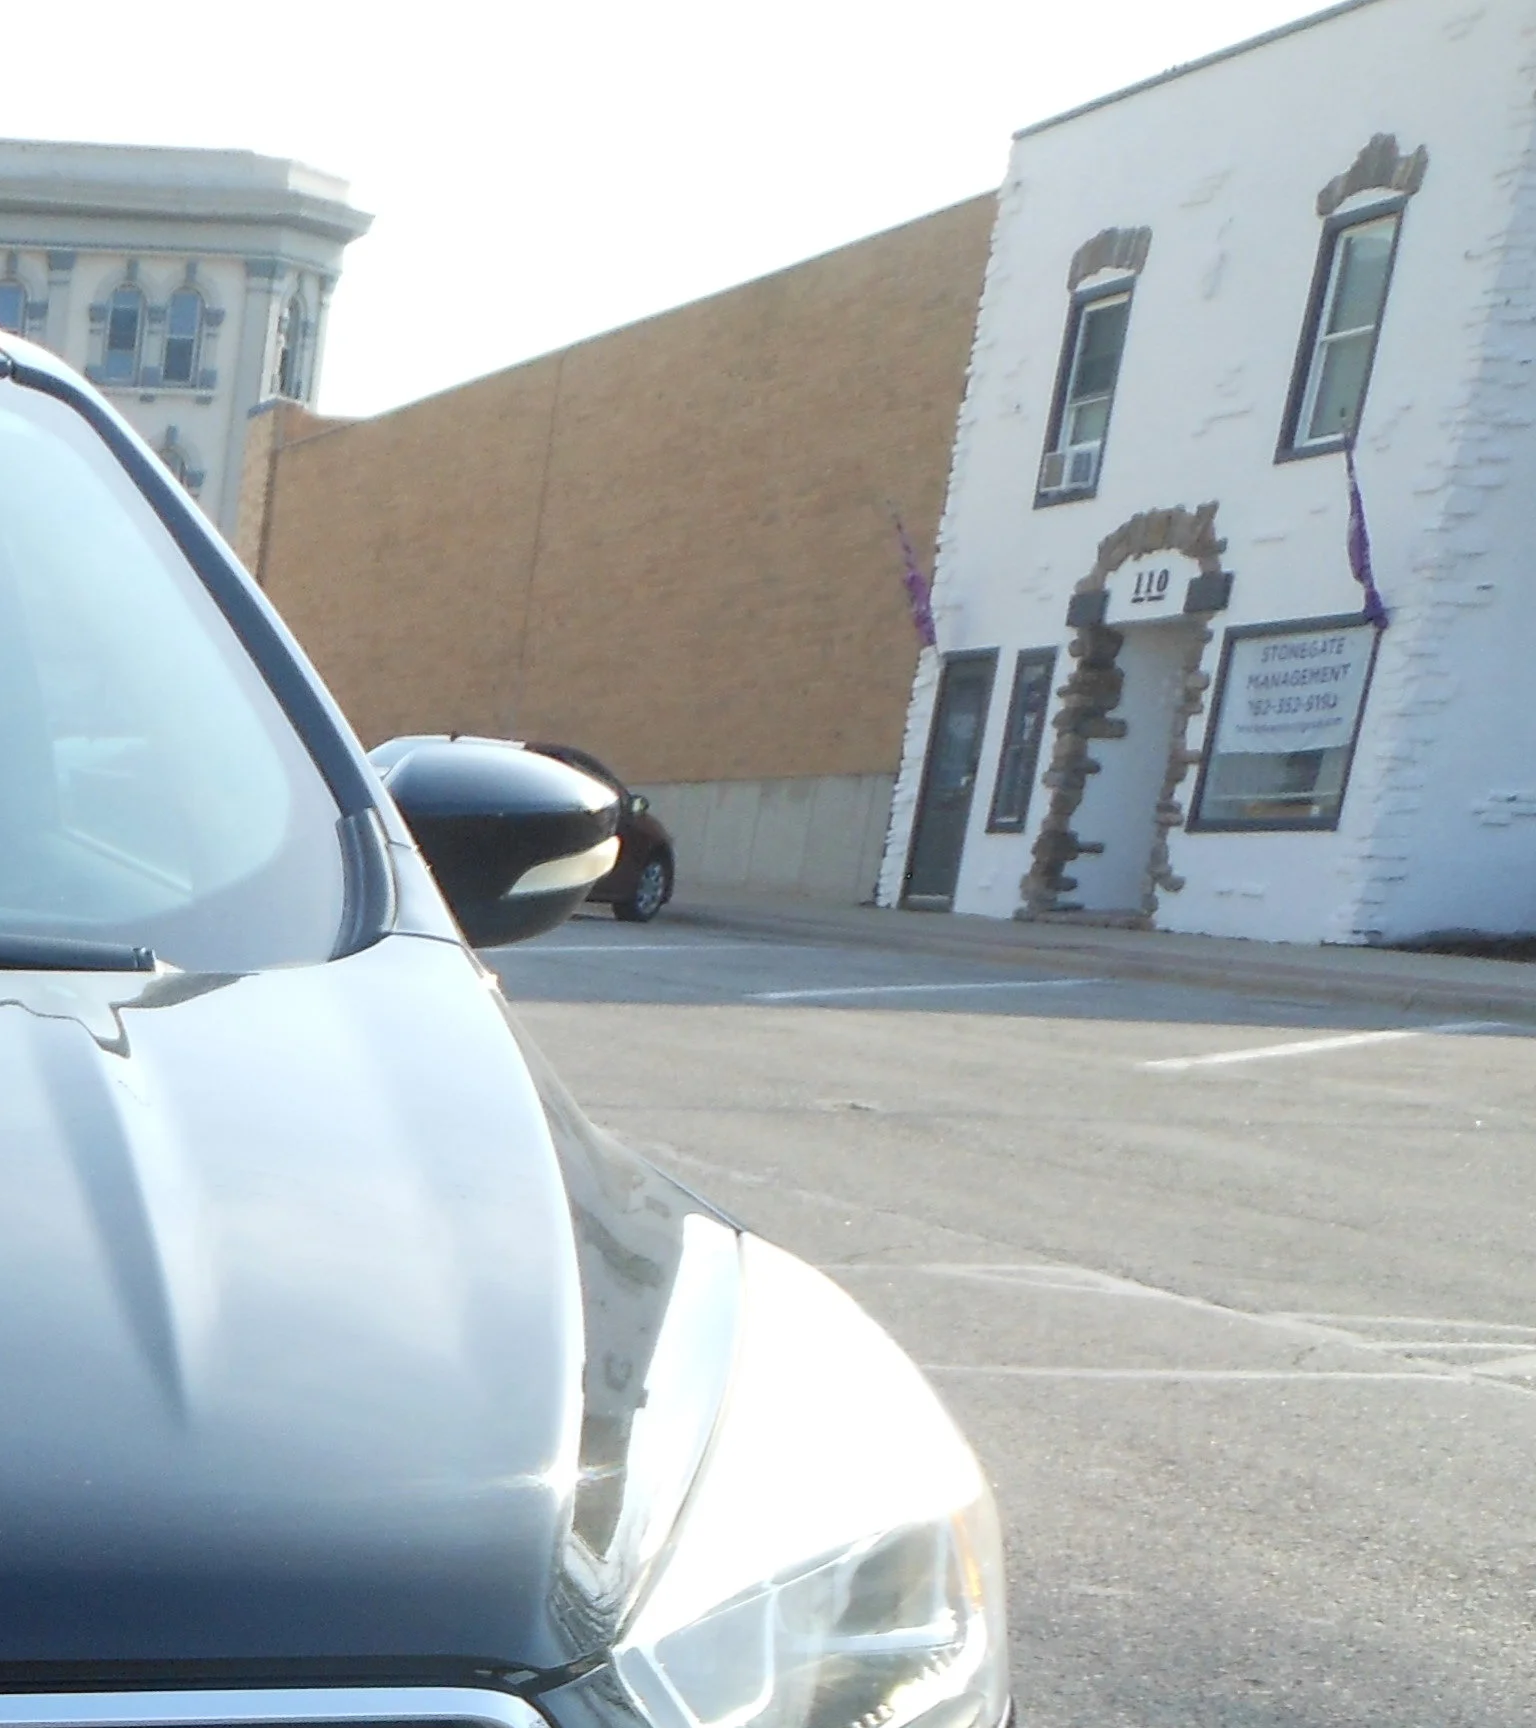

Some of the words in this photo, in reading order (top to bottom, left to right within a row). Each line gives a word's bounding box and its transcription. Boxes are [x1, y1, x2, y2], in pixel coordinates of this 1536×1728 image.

[1134, 568, 1170, 595] 110
[1260, 635, 1347, 663] STONEGATE
[1246, 662, 1351, 690] MANAGEMENT
